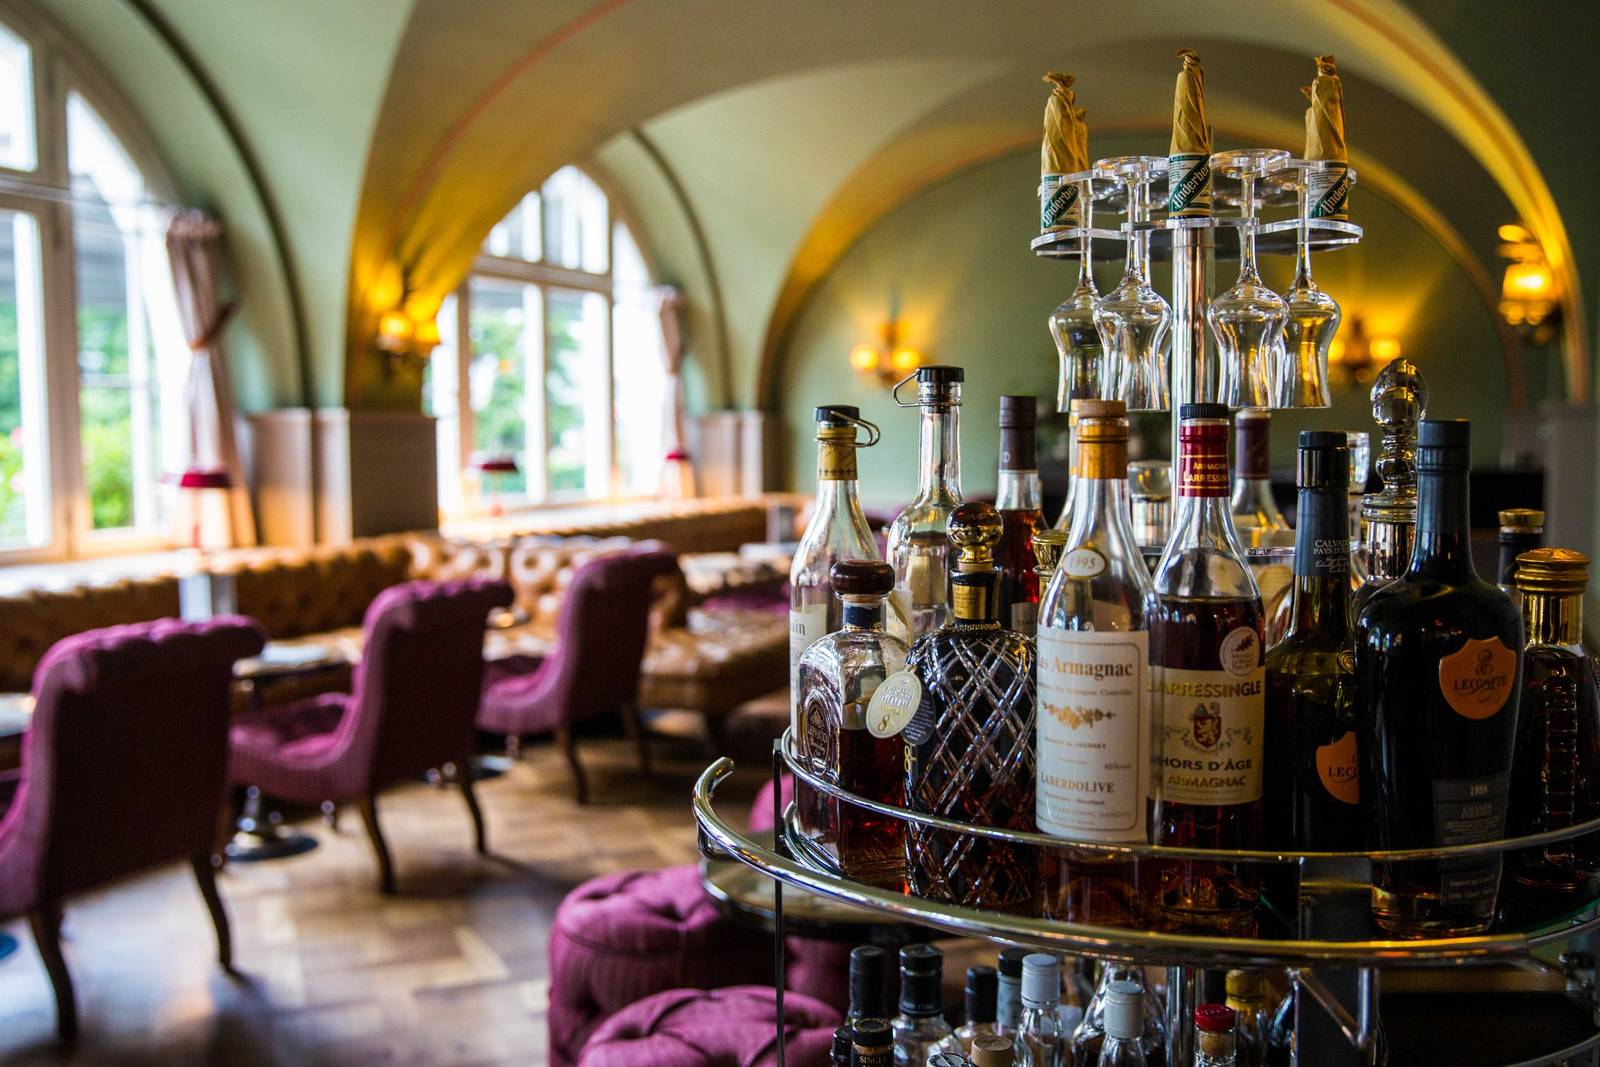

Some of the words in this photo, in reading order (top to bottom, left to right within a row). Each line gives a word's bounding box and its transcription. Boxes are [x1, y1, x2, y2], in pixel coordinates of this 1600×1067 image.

[1070, 556, 1097, 570] 1995
[1053, 655, 1134, 682] Armagnac
[877, 713, 891, 732] 8
[1158, 756, 1203, 771] HORS
[1207, 757, 1253, 772] D'ÂGE
[1040, 771, 1115, 794] LABERDOLIVE
[1166, 774, 1247, 788] ARMAGNAC
